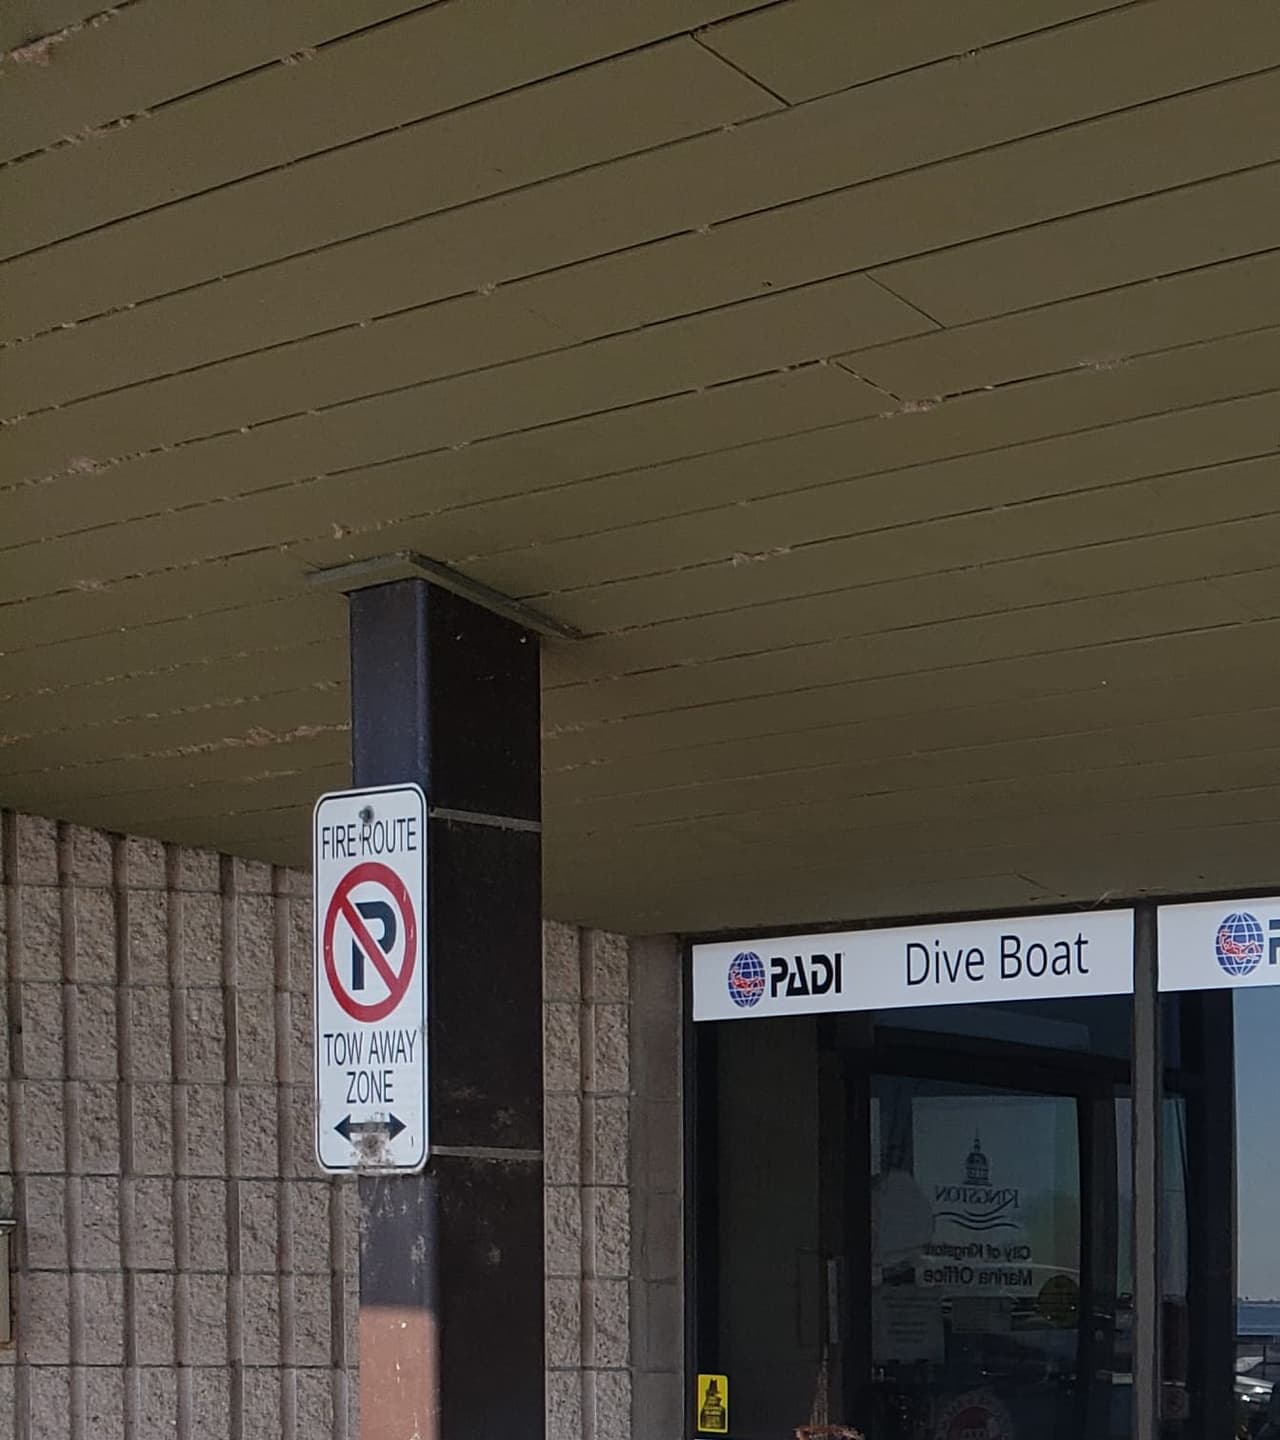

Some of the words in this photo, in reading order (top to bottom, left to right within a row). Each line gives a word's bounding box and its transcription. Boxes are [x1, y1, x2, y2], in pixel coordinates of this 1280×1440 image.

[322, 823, 357, 859] FIRE
[361, 817, 417, 856] ROUTE
[771, 952, 843, 997] PADI
[906, 939, 985, 986] Dive
[1000, 932, 1089, 979] Boat
[323, 1031, 363, 1066] TOW
[368, 1029, 417, 1064] AWAY
[346, 1070, 394, 1104] ZONE
